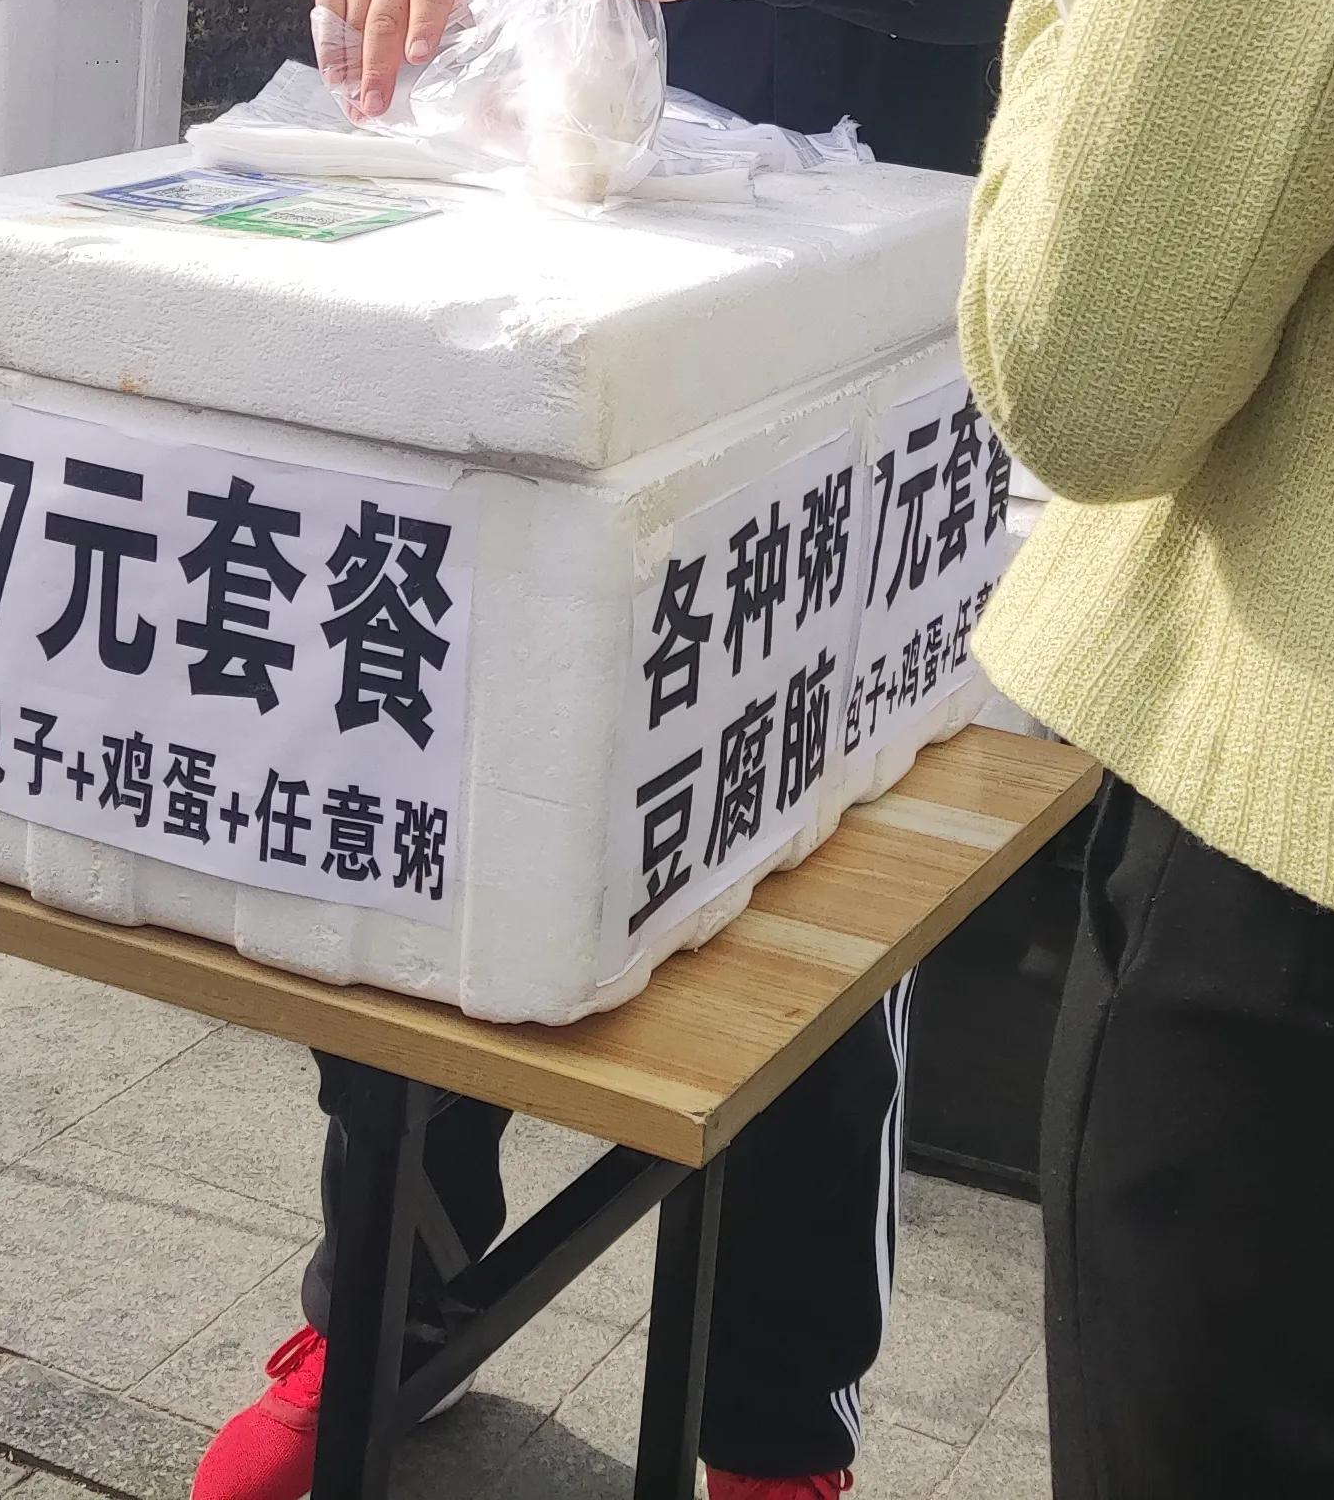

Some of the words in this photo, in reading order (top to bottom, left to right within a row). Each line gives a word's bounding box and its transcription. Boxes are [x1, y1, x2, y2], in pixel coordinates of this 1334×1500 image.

[643, 465, 853, 730] 各种粥
[628, 647, 837, 937] 豆腐脑
